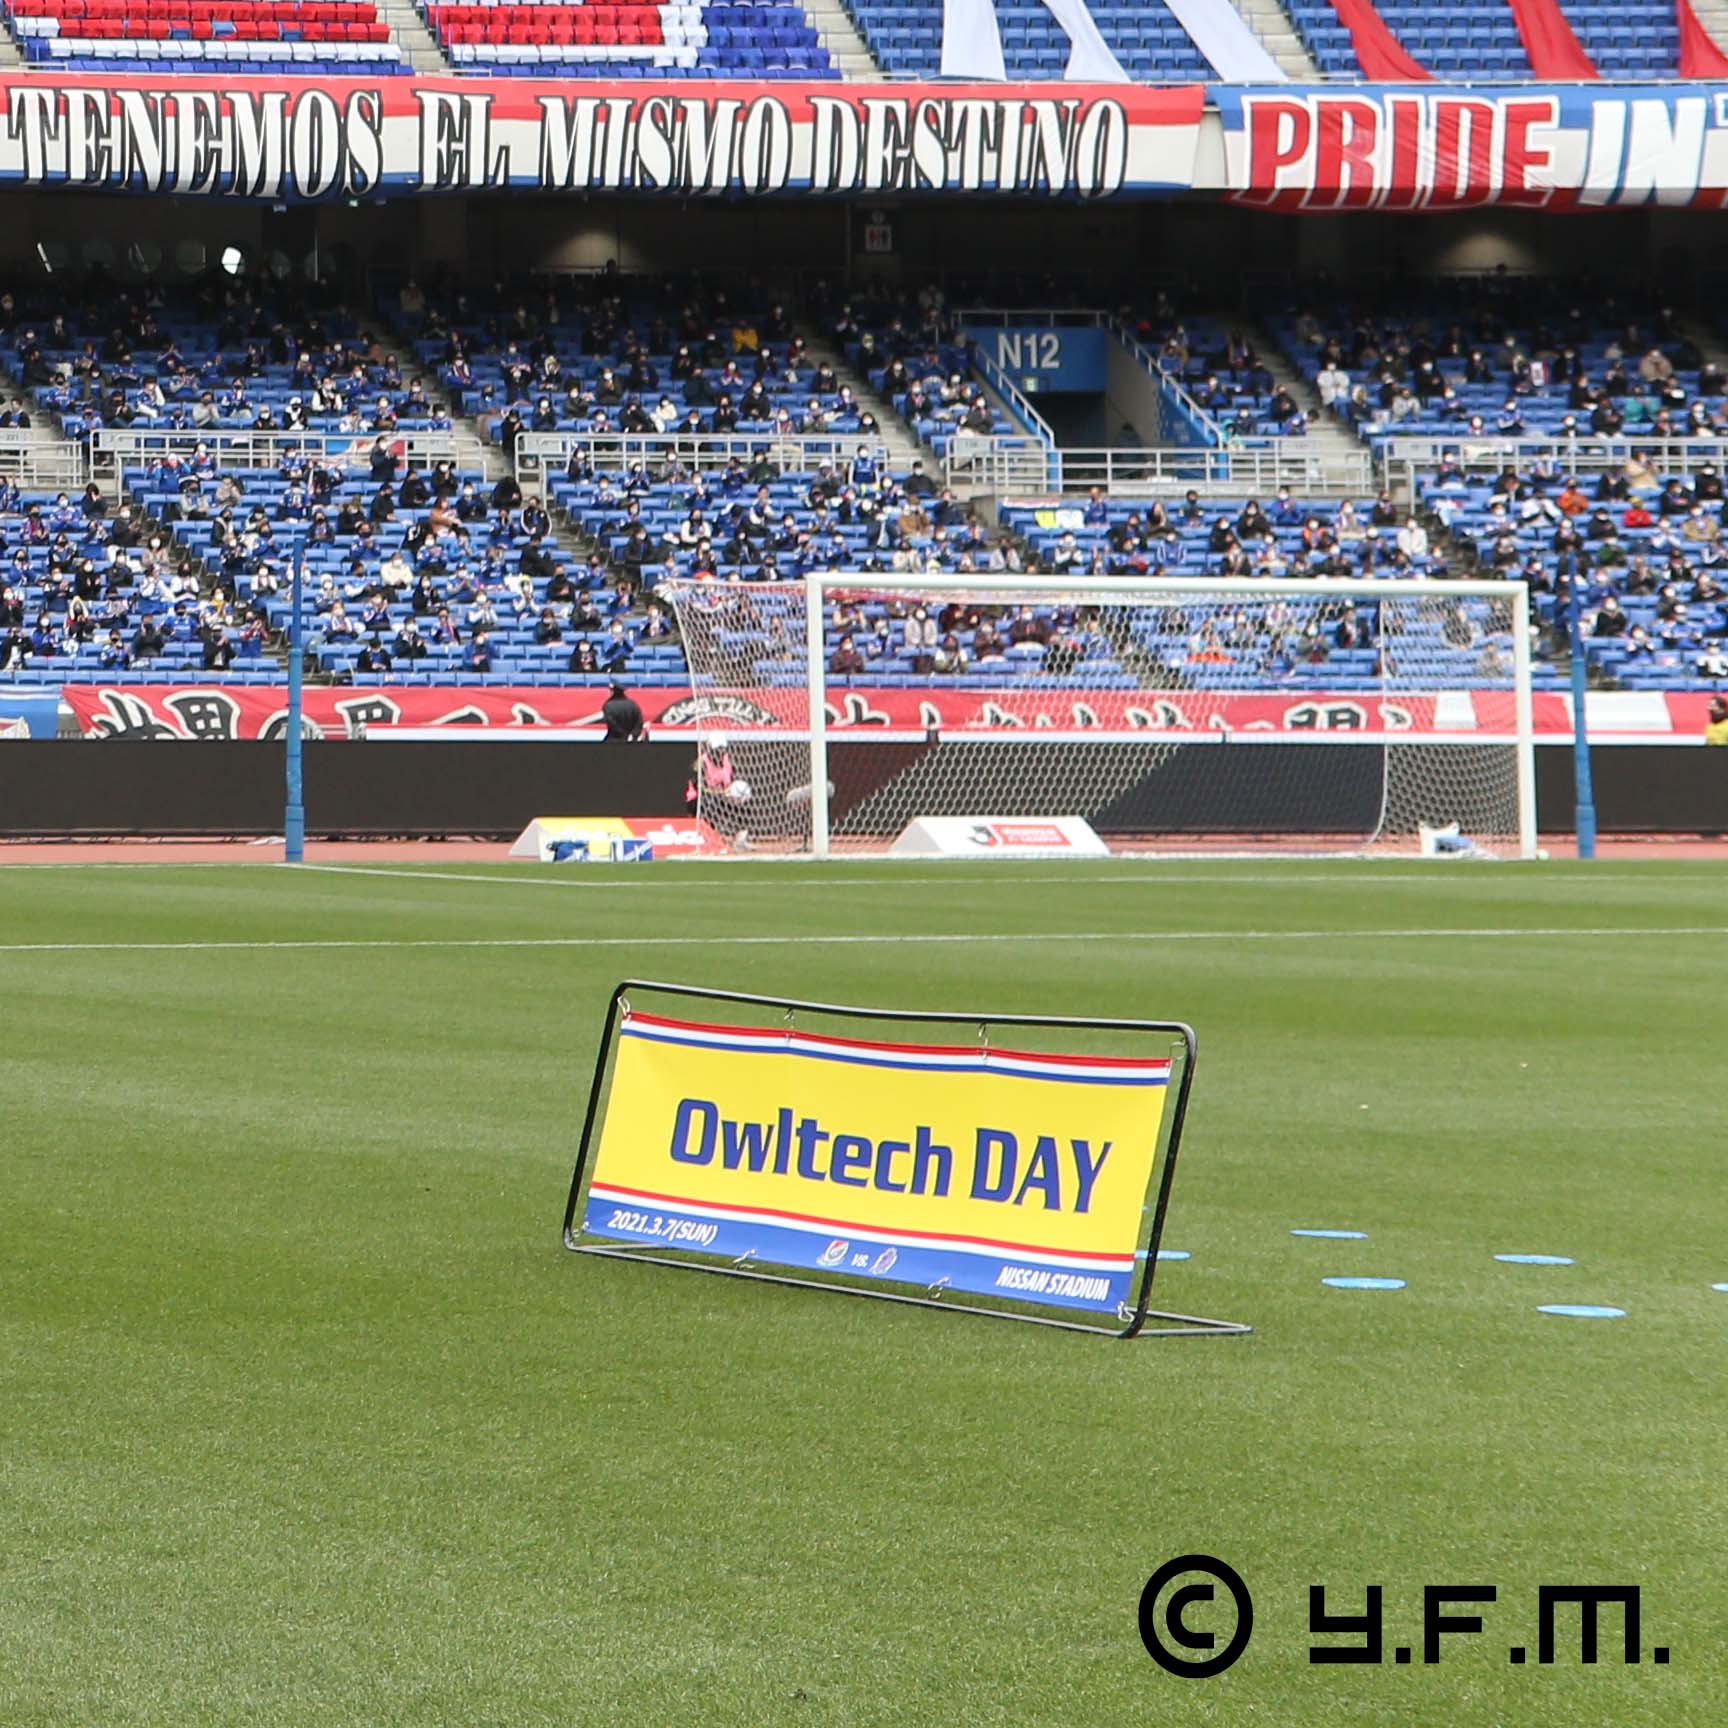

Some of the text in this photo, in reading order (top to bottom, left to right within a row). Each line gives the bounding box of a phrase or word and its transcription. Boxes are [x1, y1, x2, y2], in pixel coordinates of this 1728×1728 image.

[8, 86, 385, 199] TENEMOS
[414, 89, 511, 193] EL
[537, 95, 795, 196] MISMO
[807, 93, 1129, 199] DESTINO
[1234, 90, 1709, 210] PRIDE IN
[997, 332, 1061, 369] N12
[670, 1096, 1114, 1214] Owltech DAY
[607, 1210, 719, 1246] 2021.3.7(SUN)
[996, 1266, 1111, 1301] NISSAN STADIUM
